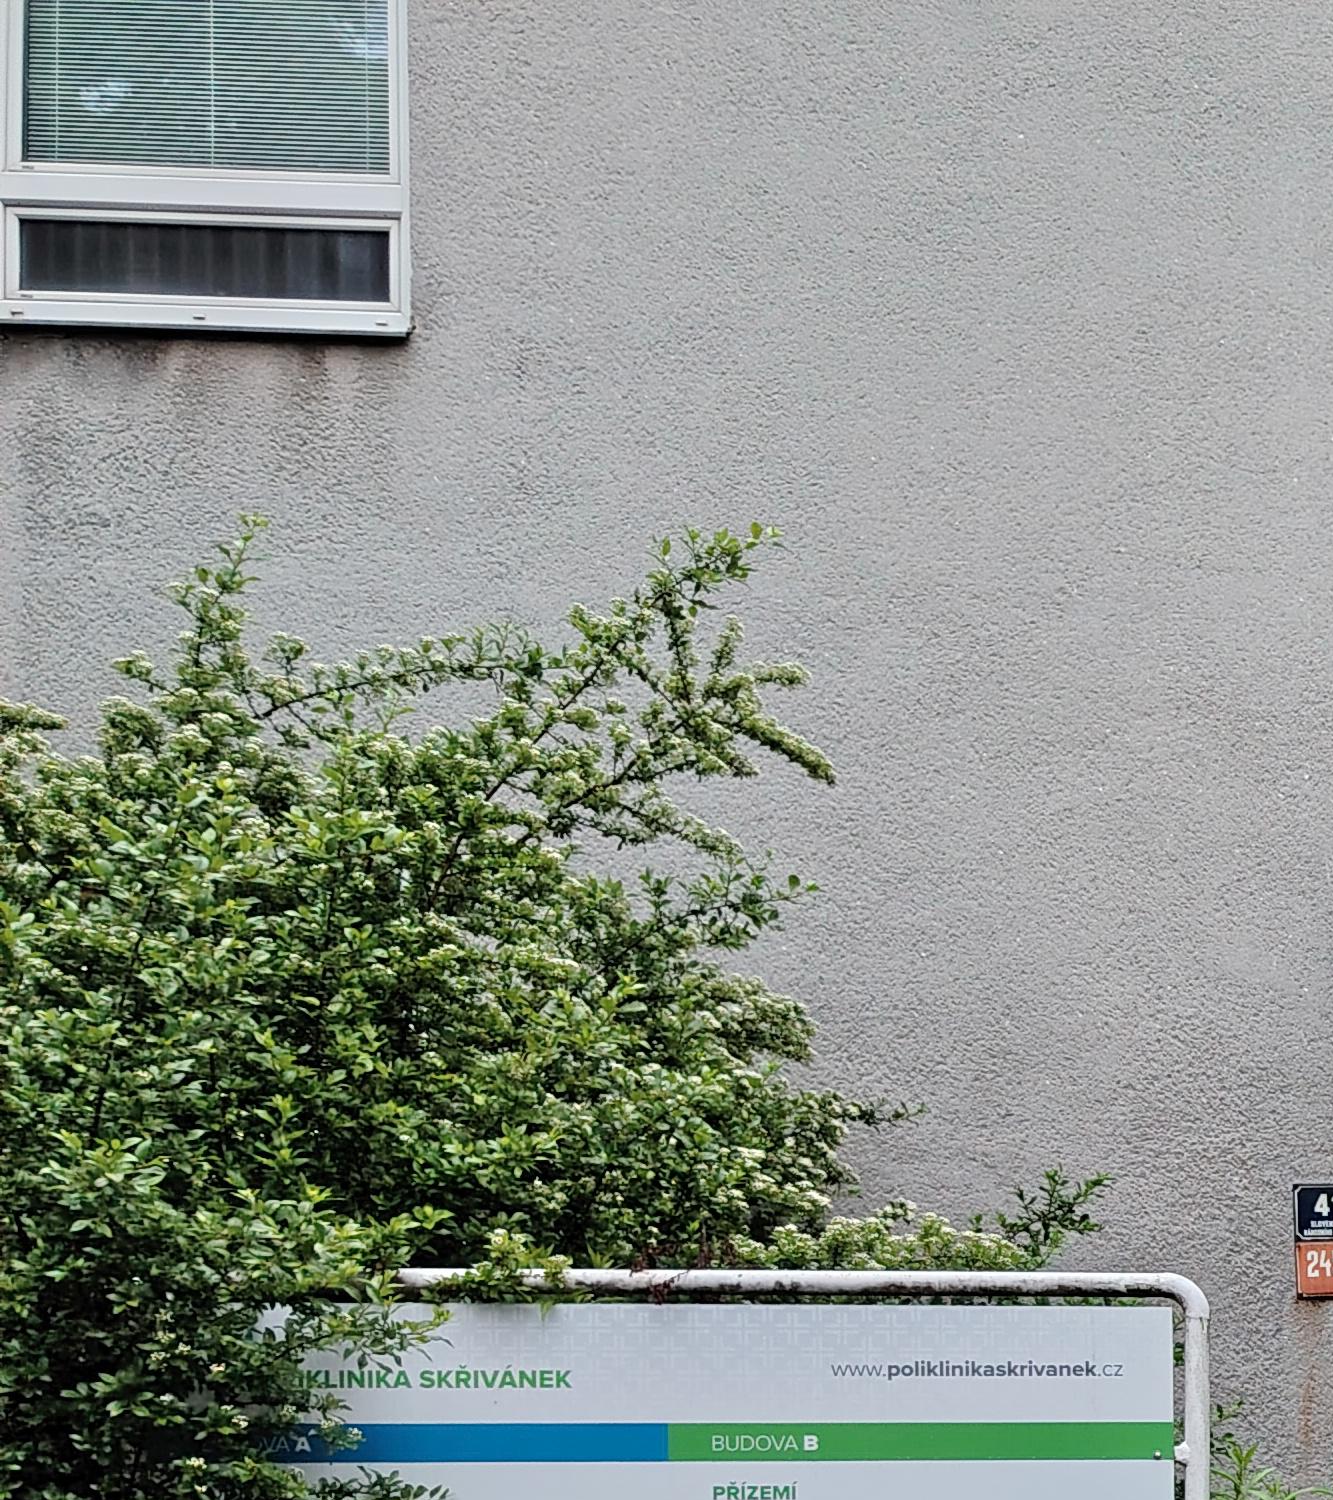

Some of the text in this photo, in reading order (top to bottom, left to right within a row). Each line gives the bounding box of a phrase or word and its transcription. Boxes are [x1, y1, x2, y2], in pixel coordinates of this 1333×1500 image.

[299, 1364, 572, 1390] IKLINIKA SKŘIVÁNEK
[831, 1360, 1123, 1380] www.poliklinikaskrivanek.cz
[711, 1434, 819, 1453] BUDOVA B
[713, 1481, 797, 1500] PŘÍZEMÍ
